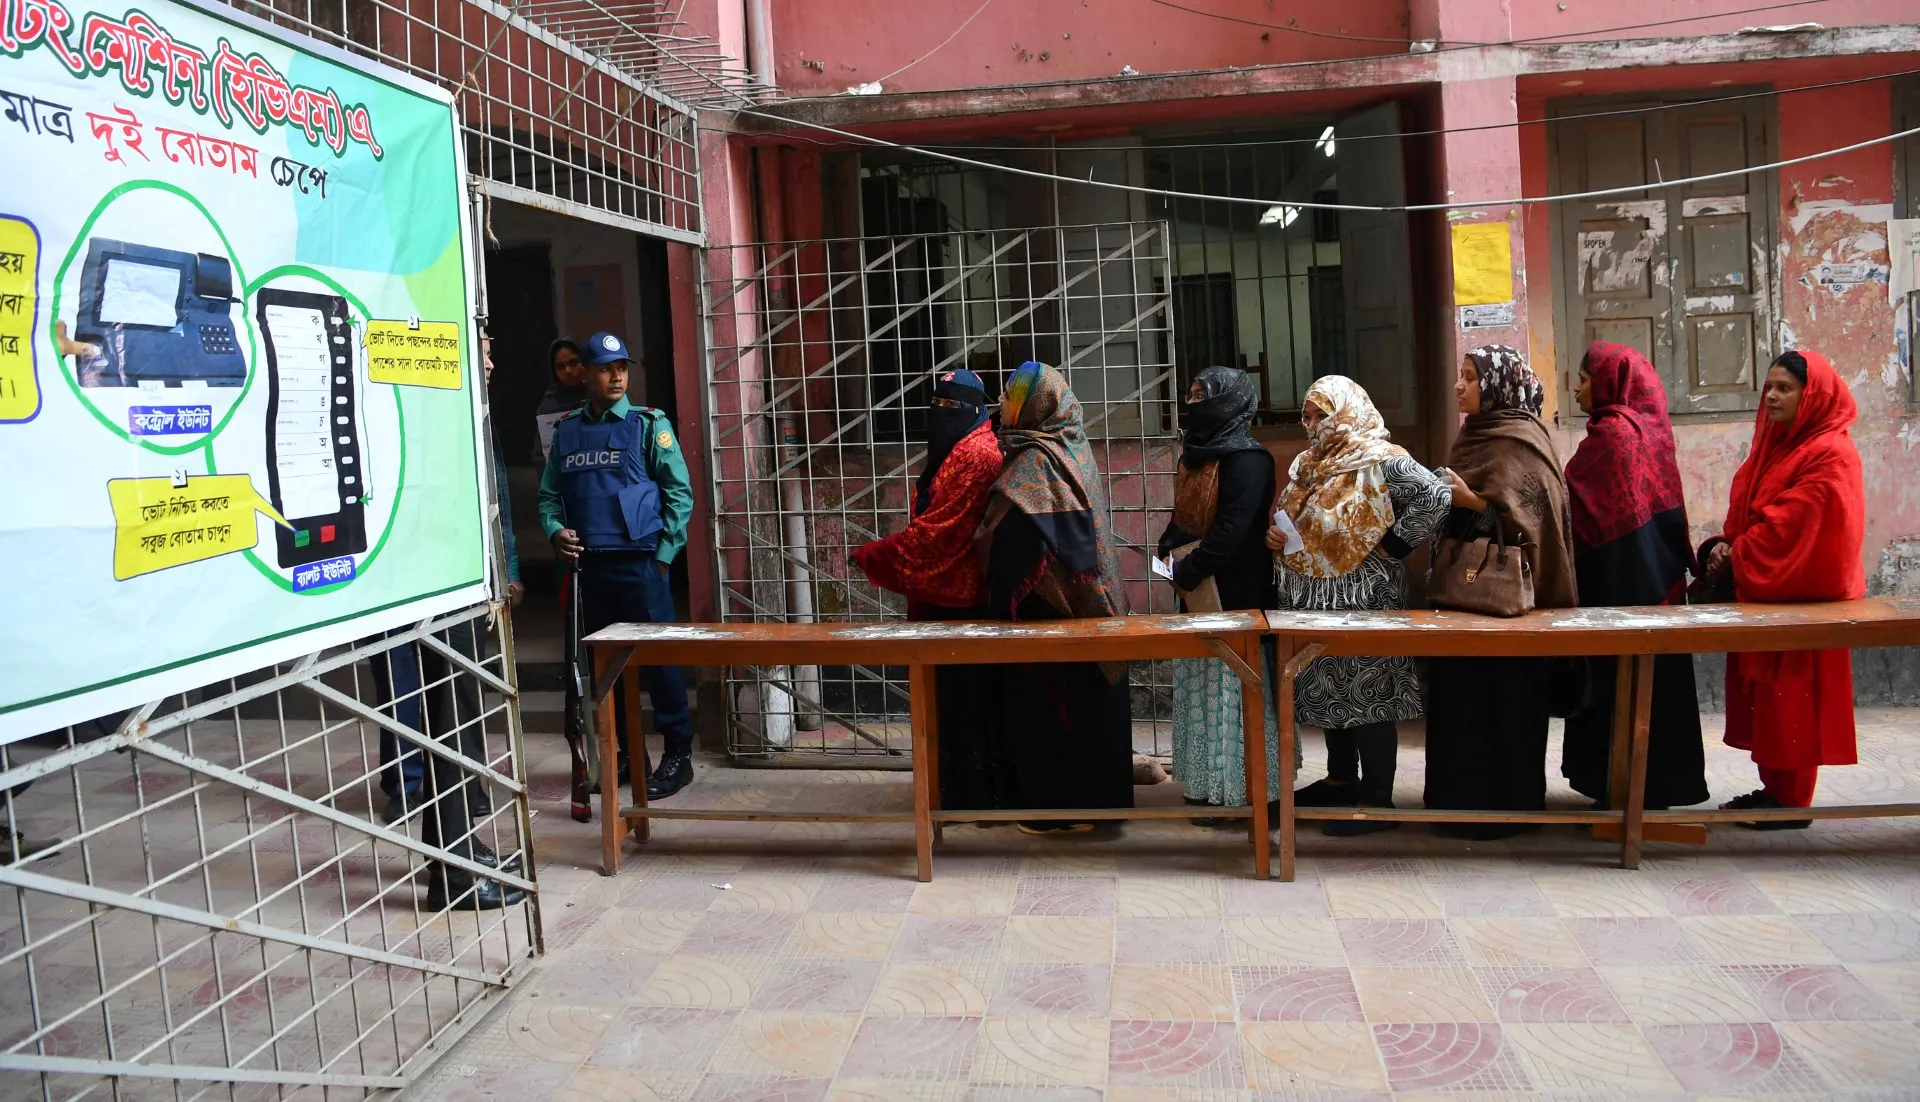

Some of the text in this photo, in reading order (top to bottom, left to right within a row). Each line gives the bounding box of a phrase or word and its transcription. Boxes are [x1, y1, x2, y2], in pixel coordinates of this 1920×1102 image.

[84, 13, 208, 109] মেশিন
[212, 40, 345, 154] (ইভিএম)
[345, 104, 385, 156] এ
[0, 89, 328, 199] মাত্র দুই বোতাম চেপে
[369, 330, 458, 350] ভোট দিতে পছন্দের প্রতীকের
[372, 357, 395, 370] পাশের
[397, 358, 412, 371] সাদা
[443, 360, 459, 374] চাপুন
[133, 407, 211, 432] কন্ট্রোল ইউনিট
[566, 451, 621, 468] POLICE
[140, 495, 230, 522] ভোট নিশ্চিত করতে
[140, 524, 232, 554] সবুজ বোতাম চাপুন
[296, 558, 352, 588] ব্যালট ইউনিট
